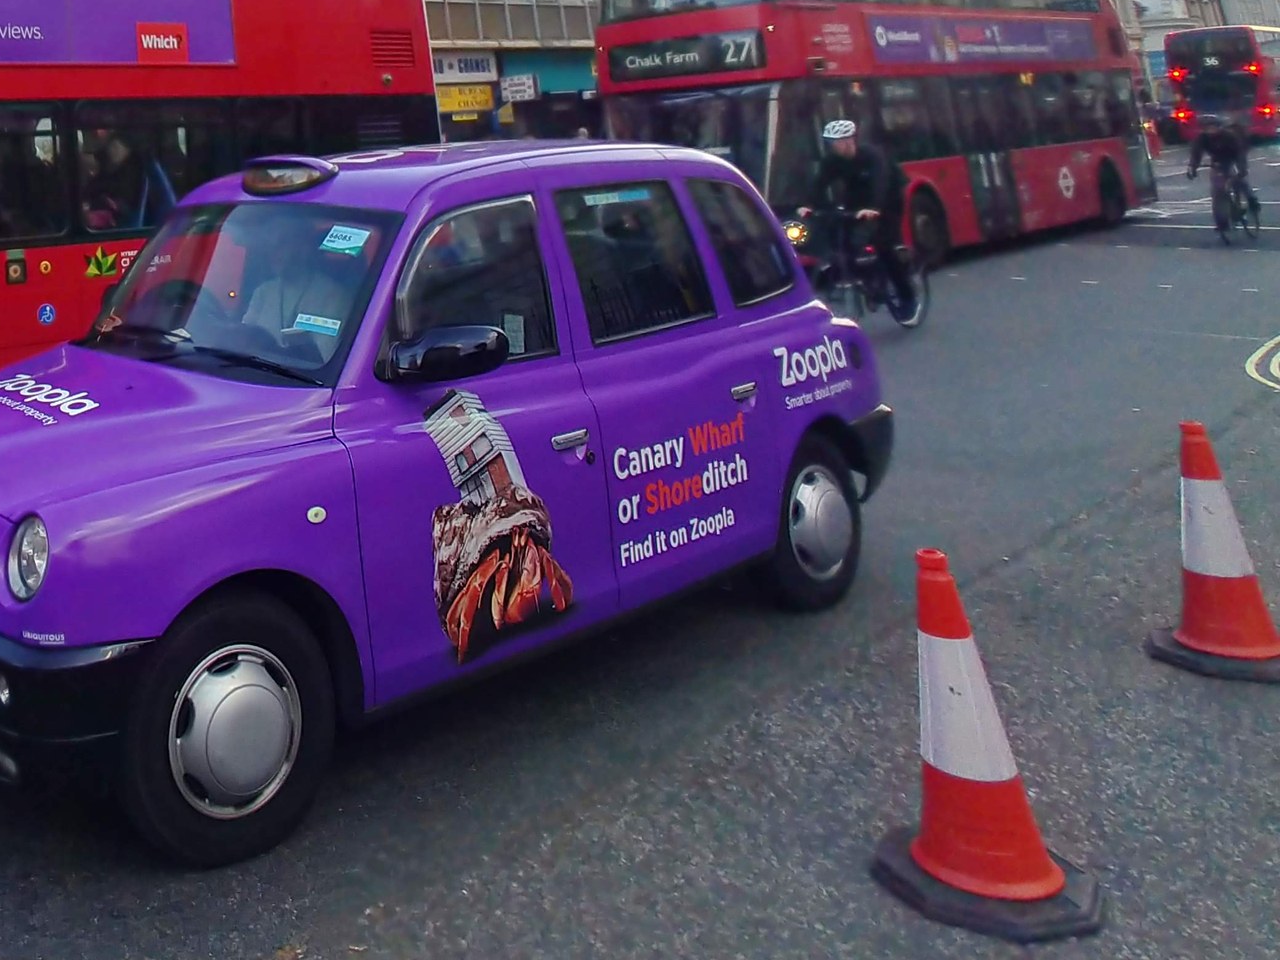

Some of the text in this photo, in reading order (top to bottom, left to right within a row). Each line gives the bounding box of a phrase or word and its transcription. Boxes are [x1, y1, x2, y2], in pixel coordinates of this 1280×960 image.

[625, 51, 700, 69] Chalk Farm
[1203, 56, 1220, 67] 36
[773, 335, 848, 387] Zoopla
[785, 393, 814, 410] Smarter
[13, 403, 58, 426] property
[613, 411, 745, 480] Canary Wharf
[618, 453, 749, 524] or Shoreditch
[620, 506, 736, 567] Find it on Zoopla
[22, 630, 65, 642] UBIQUITOUS
